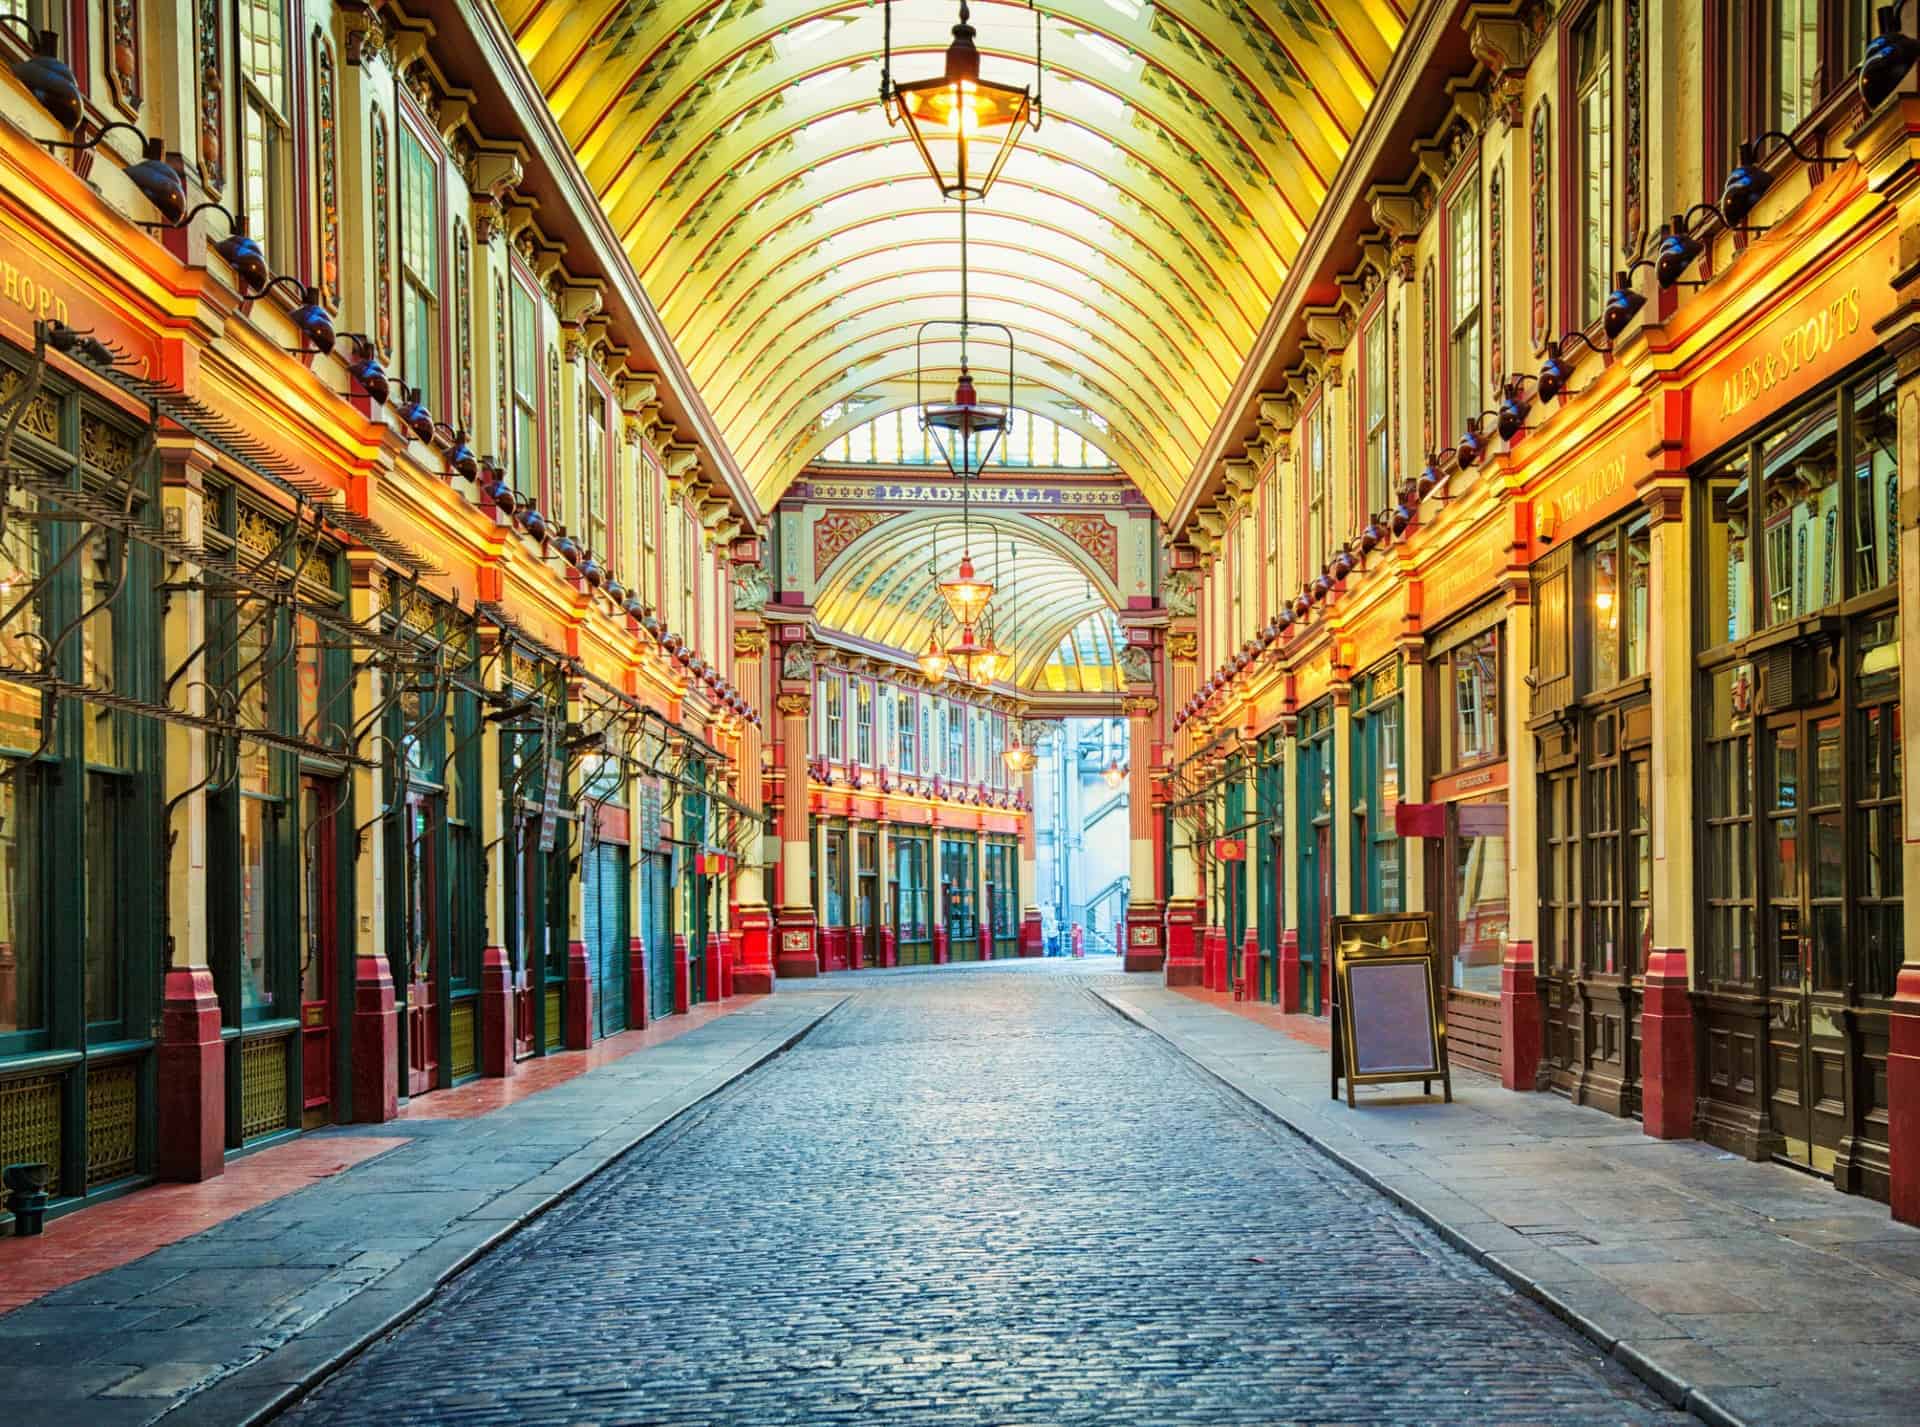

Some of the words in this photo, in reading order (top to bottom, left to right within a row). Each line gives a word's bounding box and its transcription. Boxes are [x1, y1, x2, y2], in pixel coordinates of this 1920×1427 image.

[1720, 357, 1761, 422] ALES
[1762, 352, 1778, 391] &
[1780, 287, 1862, 380] STOUTS
[883, 486, 1053, 502] LEADENHALL
